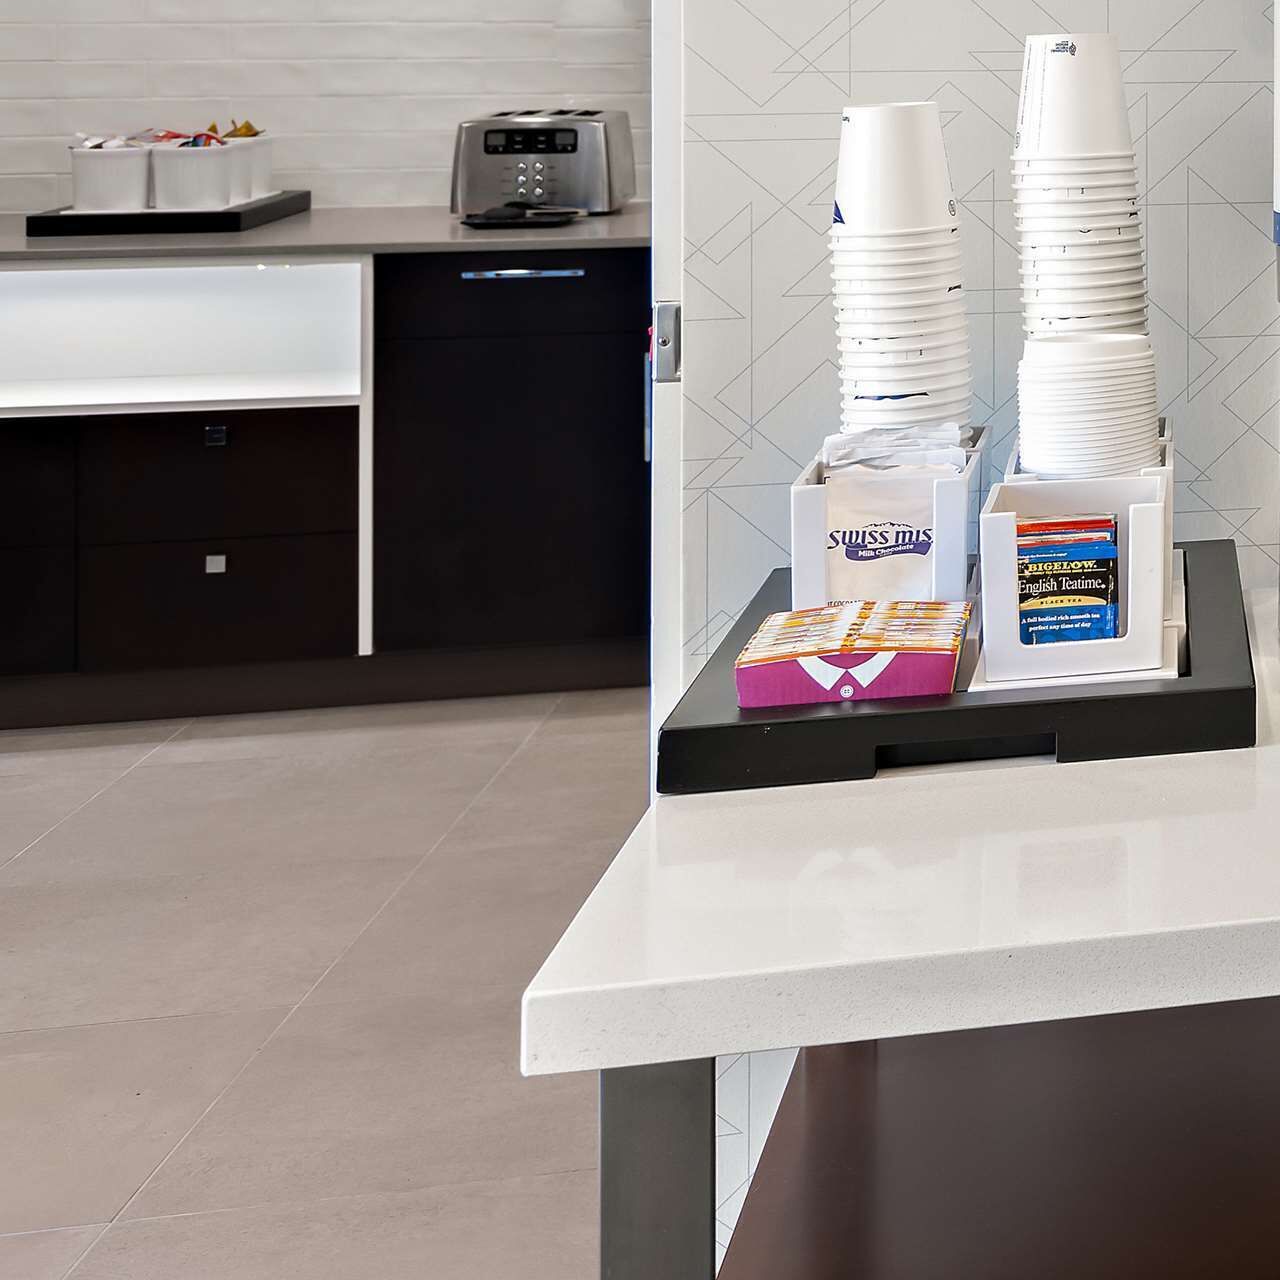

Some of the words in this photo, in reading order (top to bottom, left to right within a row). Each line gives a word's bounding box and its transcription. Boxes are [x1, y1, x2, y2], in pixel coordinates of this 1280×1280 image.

[827, 530, 889, 549] SWISS
[895, 529, 933, 544] MIS
[876, 544, 914, 556] Chocolate
[1018, 578, 1057, 595] English
